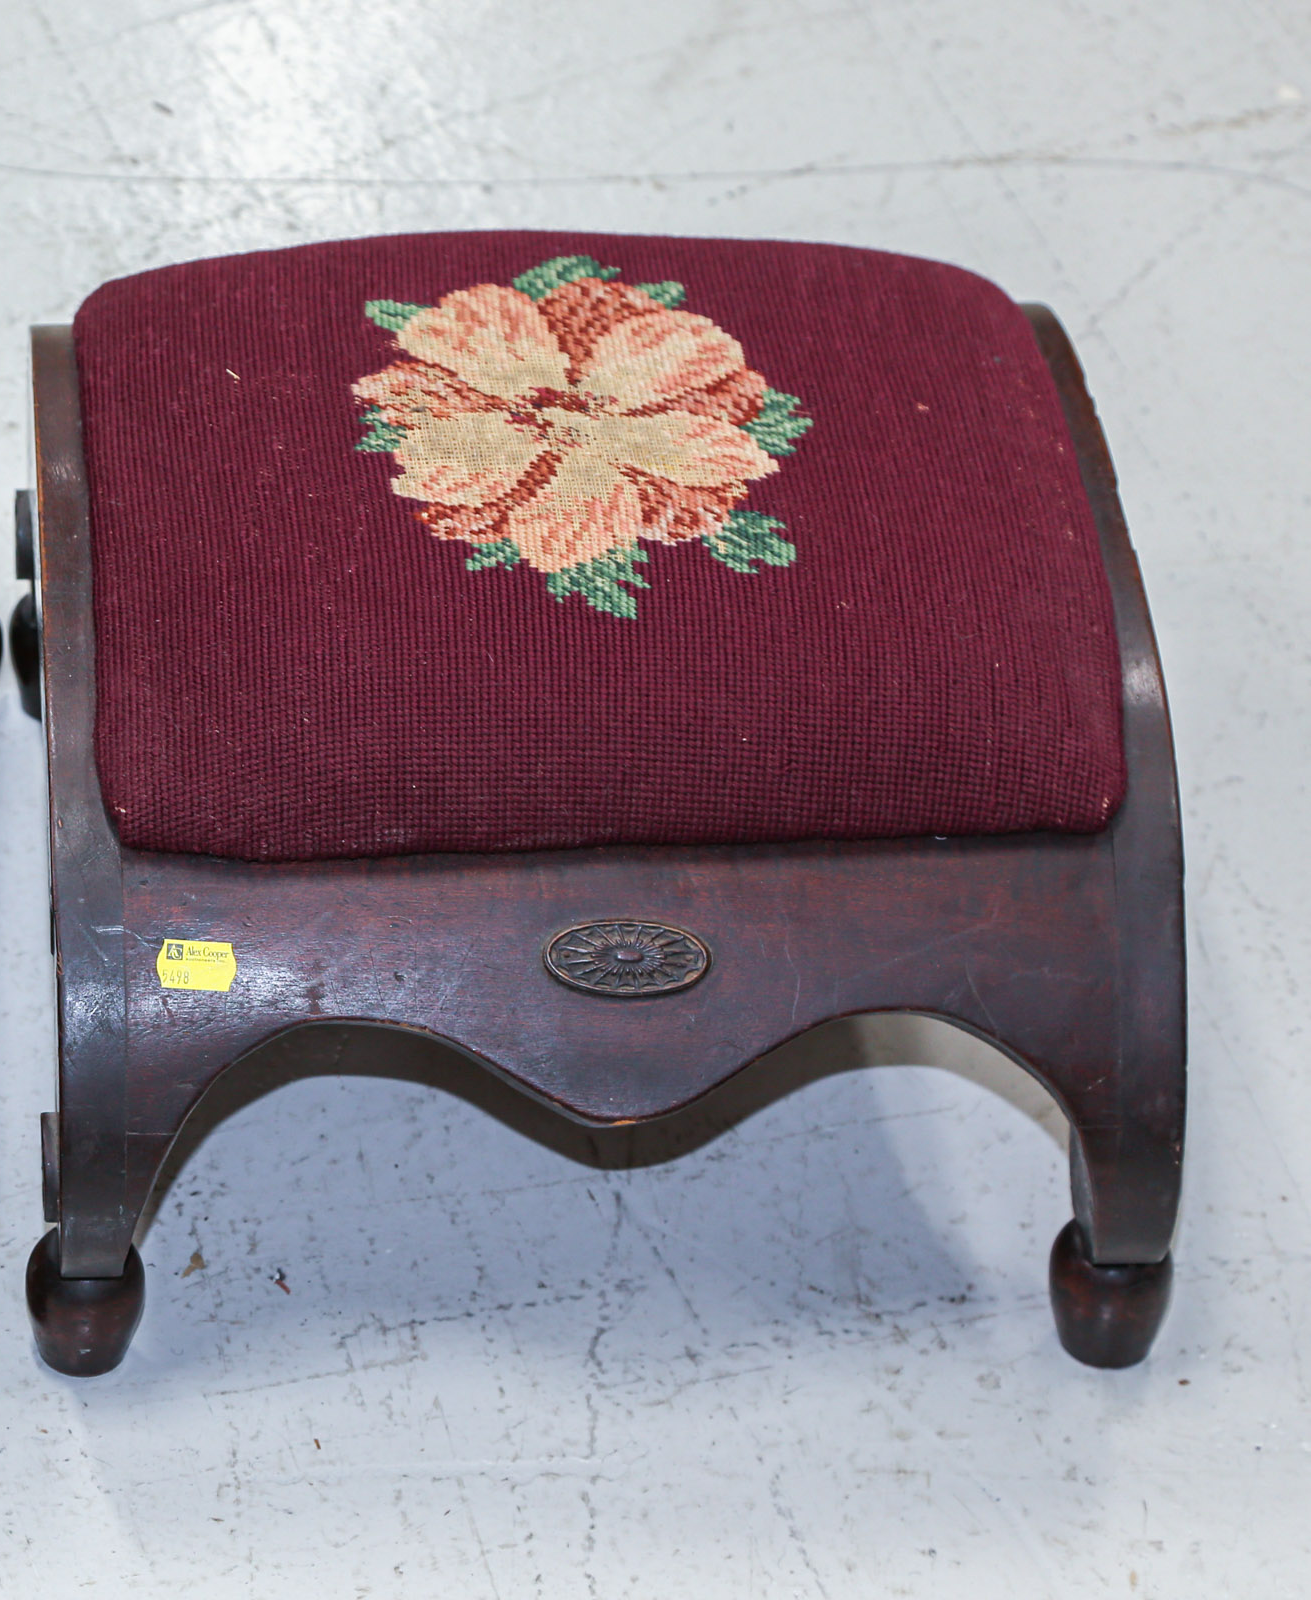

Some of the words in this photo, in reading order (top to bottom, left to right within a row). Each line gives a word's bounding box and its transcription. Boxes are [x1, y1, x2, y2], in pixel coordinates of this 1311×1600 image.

[186, 946, 201, 956] Alex
[202, 946, 230, 960] Cooper
[162, 969, 189, 984] 5498
